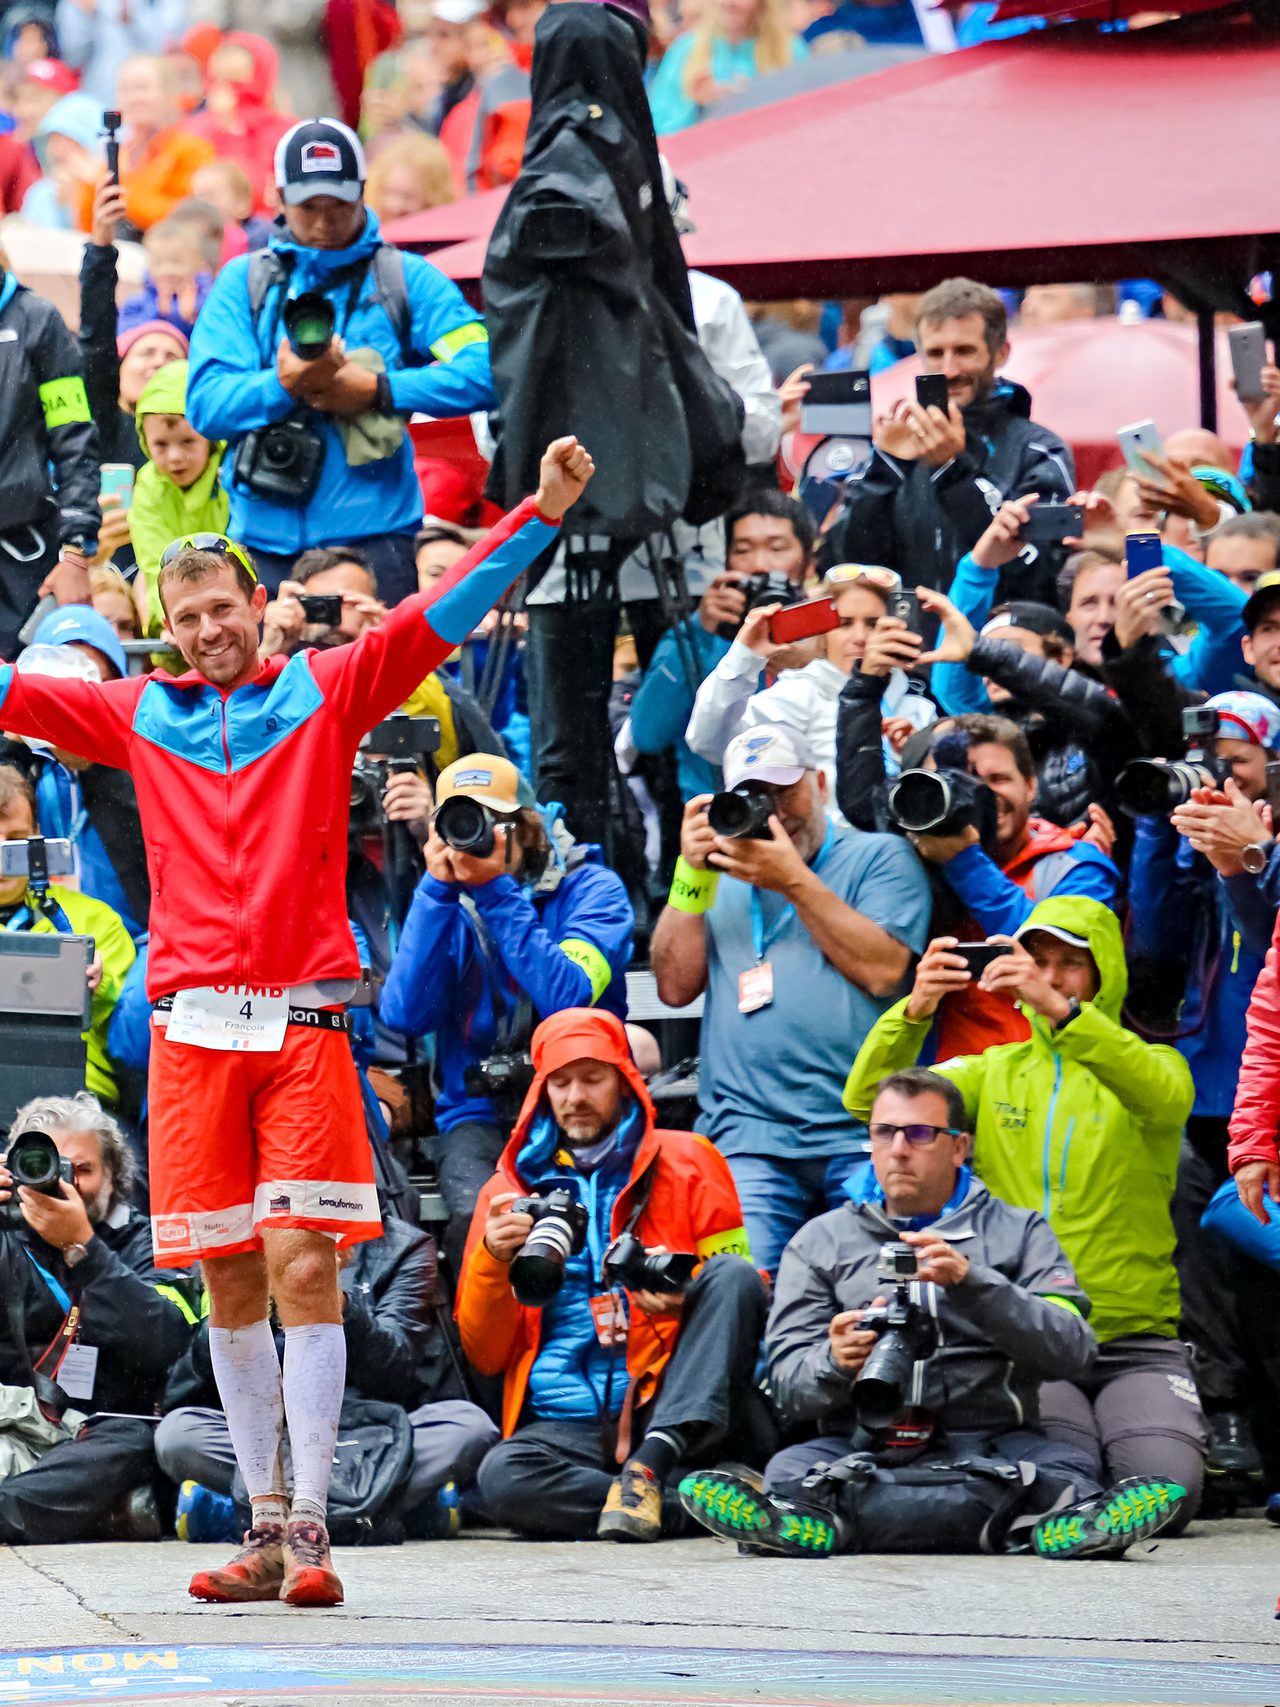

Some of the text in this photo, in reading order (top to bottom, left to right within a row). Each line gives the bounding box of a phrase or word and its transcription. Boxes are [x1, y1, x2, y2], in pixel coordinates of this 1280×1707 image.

[239, 1000, 253, 1020] 4
[224, 1021, 265, 1032] François
[63, 1306, 79, 1336] EOS
